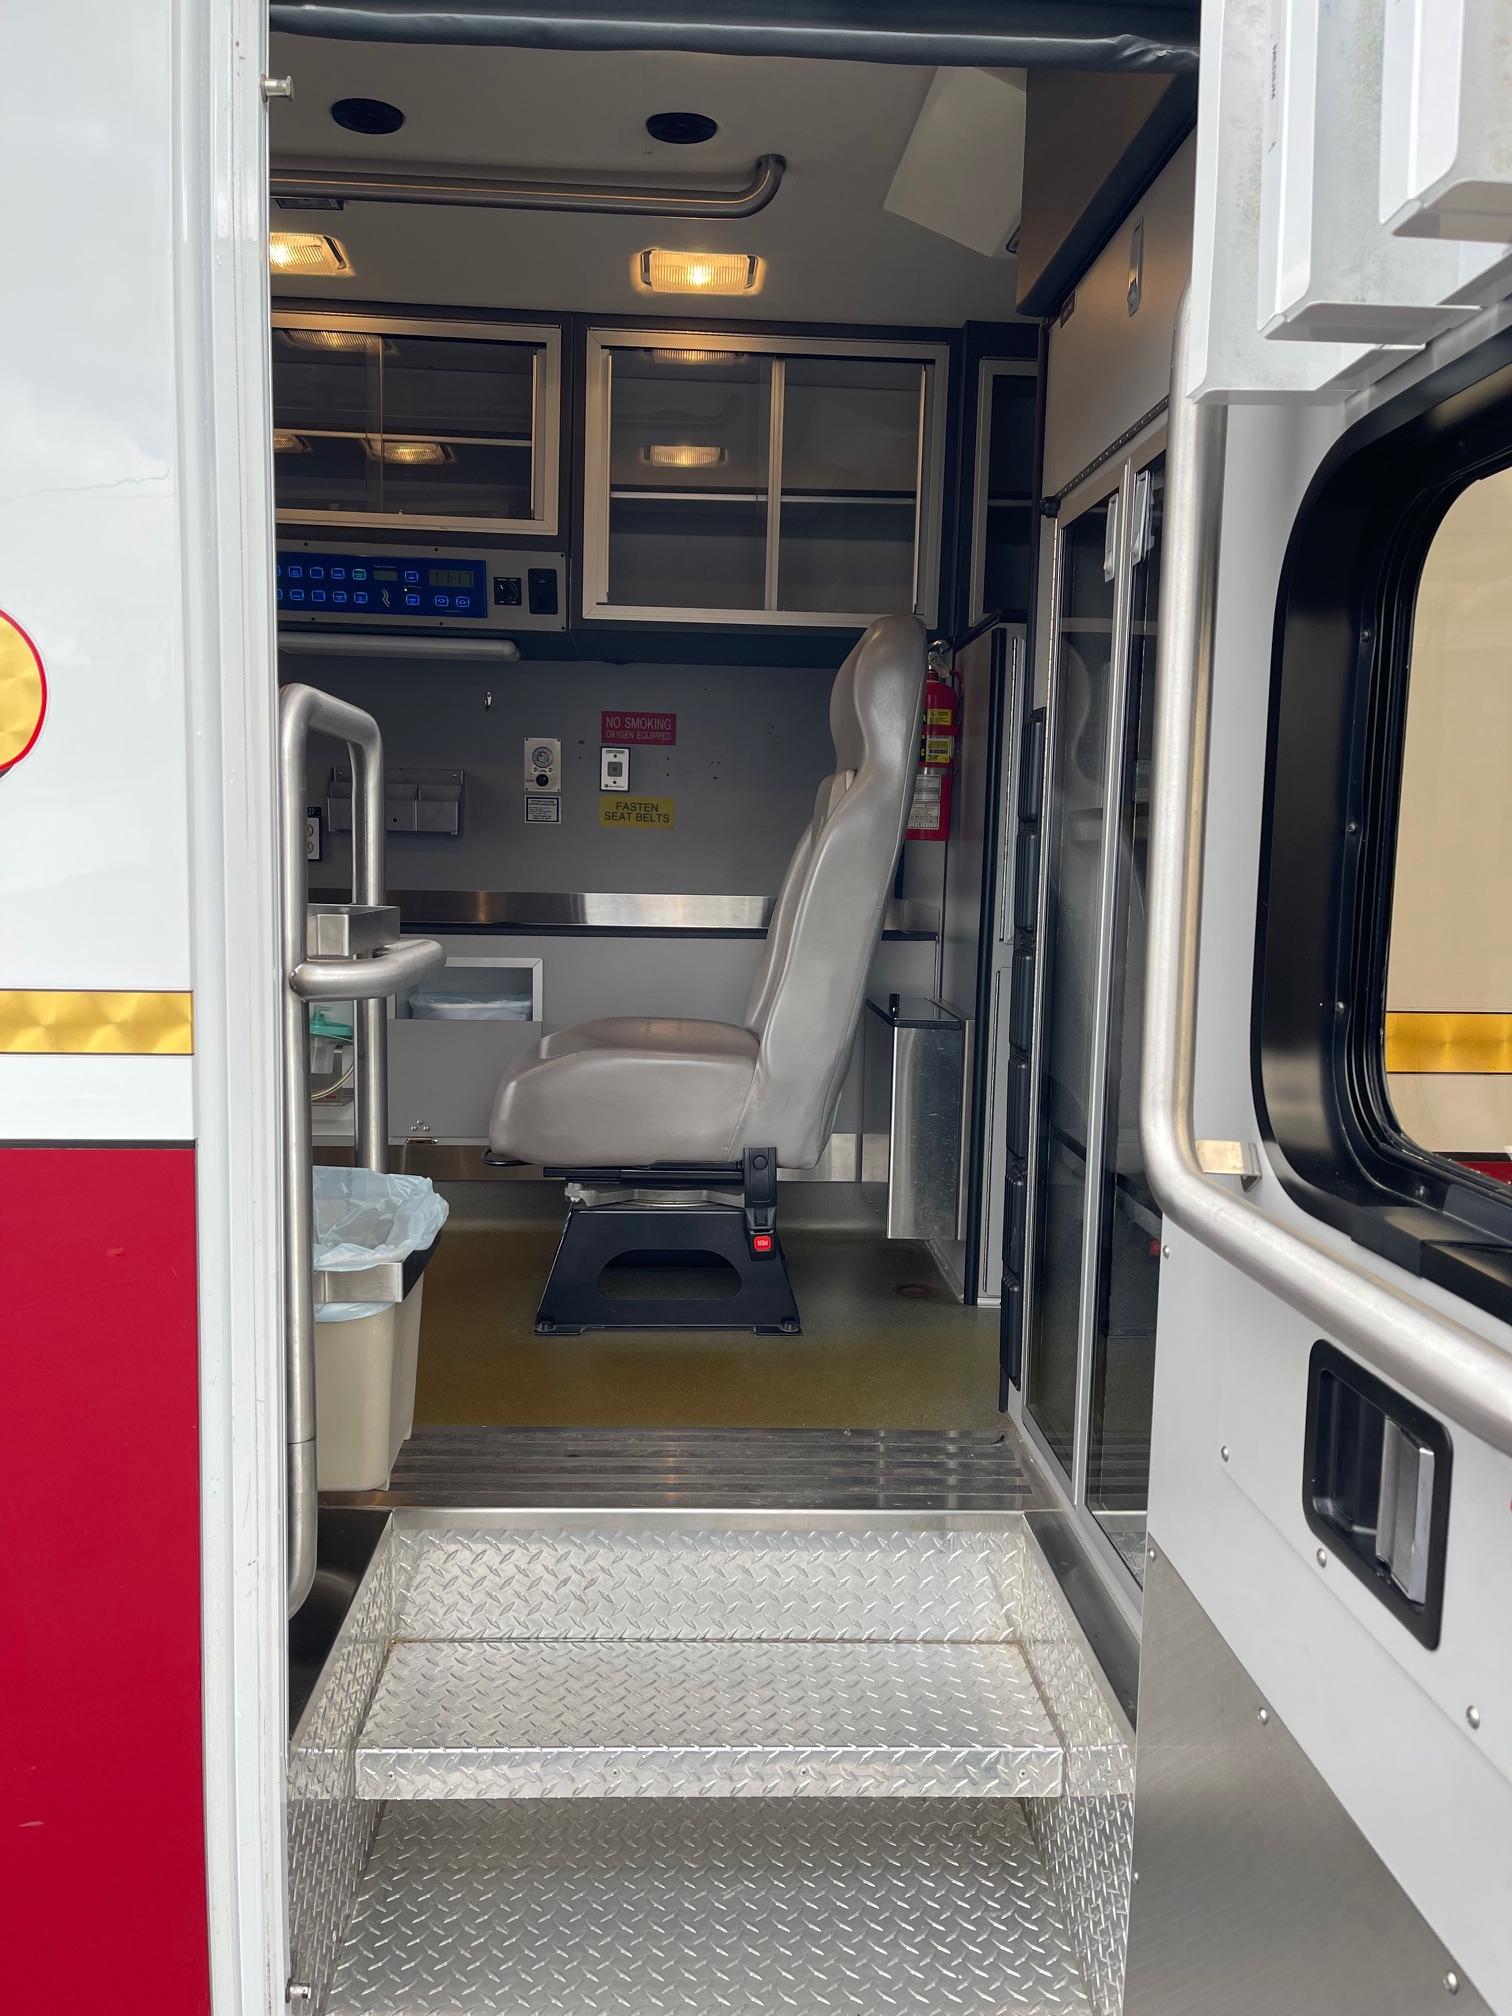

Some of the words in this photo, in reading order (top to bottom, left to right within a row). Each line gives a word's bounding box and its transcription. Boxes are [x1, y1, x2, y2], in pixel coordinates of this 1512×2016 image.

[606, 716, 621, 728] NO
[624, 717, 672, 730] SMOKING
[606, 729, 635, 739] OXYGEN
[637, 731, 672, 740] EQUIPPED
[616, 801, 659, 812] FASTEN
[604, 811, 633, 821] SEAT
[635, 813, 670, 823] BELTS
